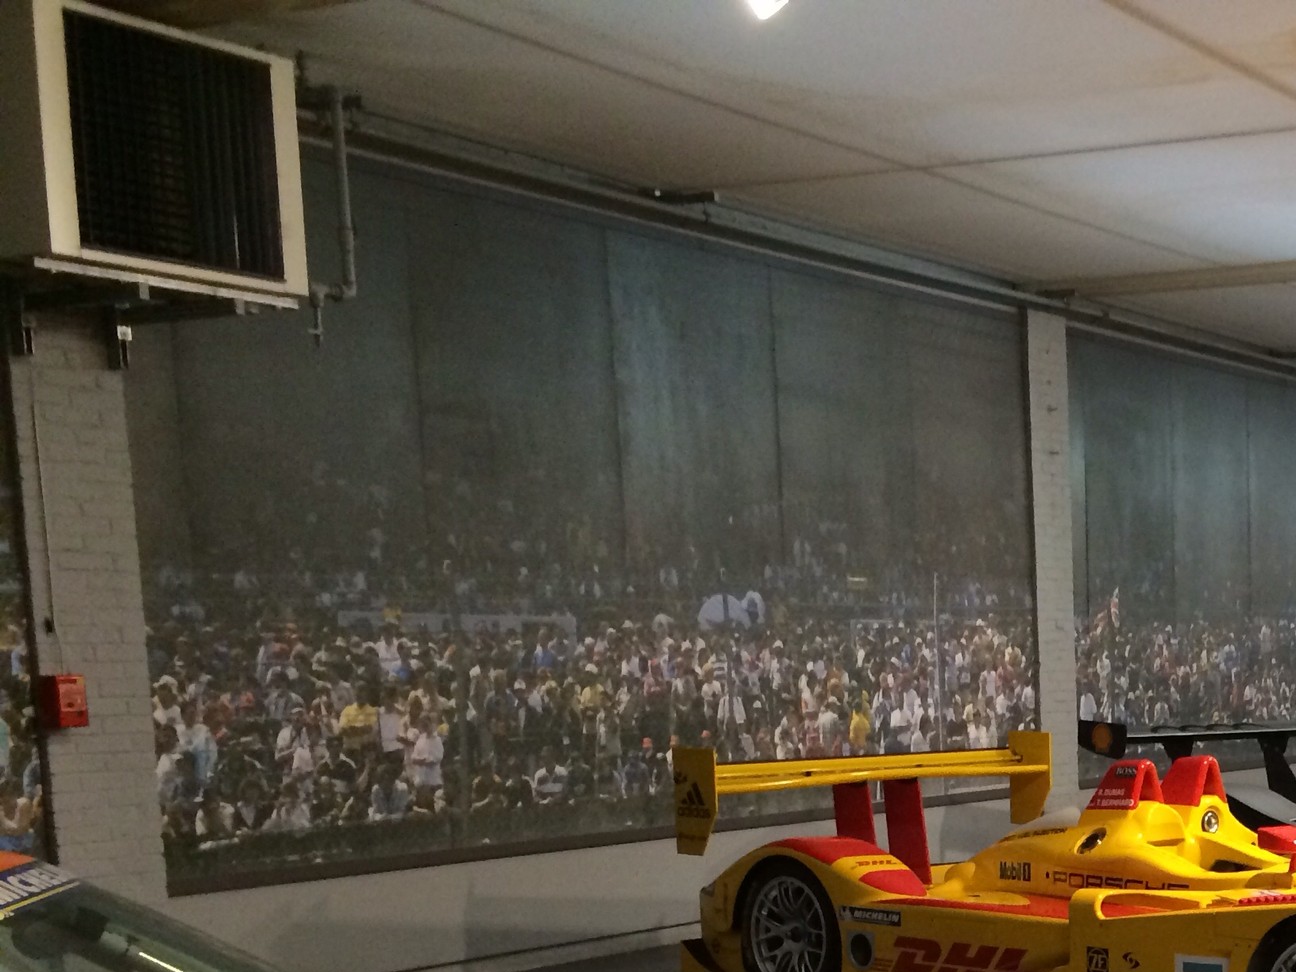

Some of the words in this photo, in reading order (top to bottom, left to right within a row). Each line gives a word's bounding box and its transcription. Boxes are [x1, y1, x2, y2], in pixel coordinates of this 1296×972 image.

[1116, 767, 1137, 775] BOSS
[999, 861, 1022, 881] Mobil
[1023, 861, 1031, 881] 1
[853, 910, 900, 923] MICHELIN
